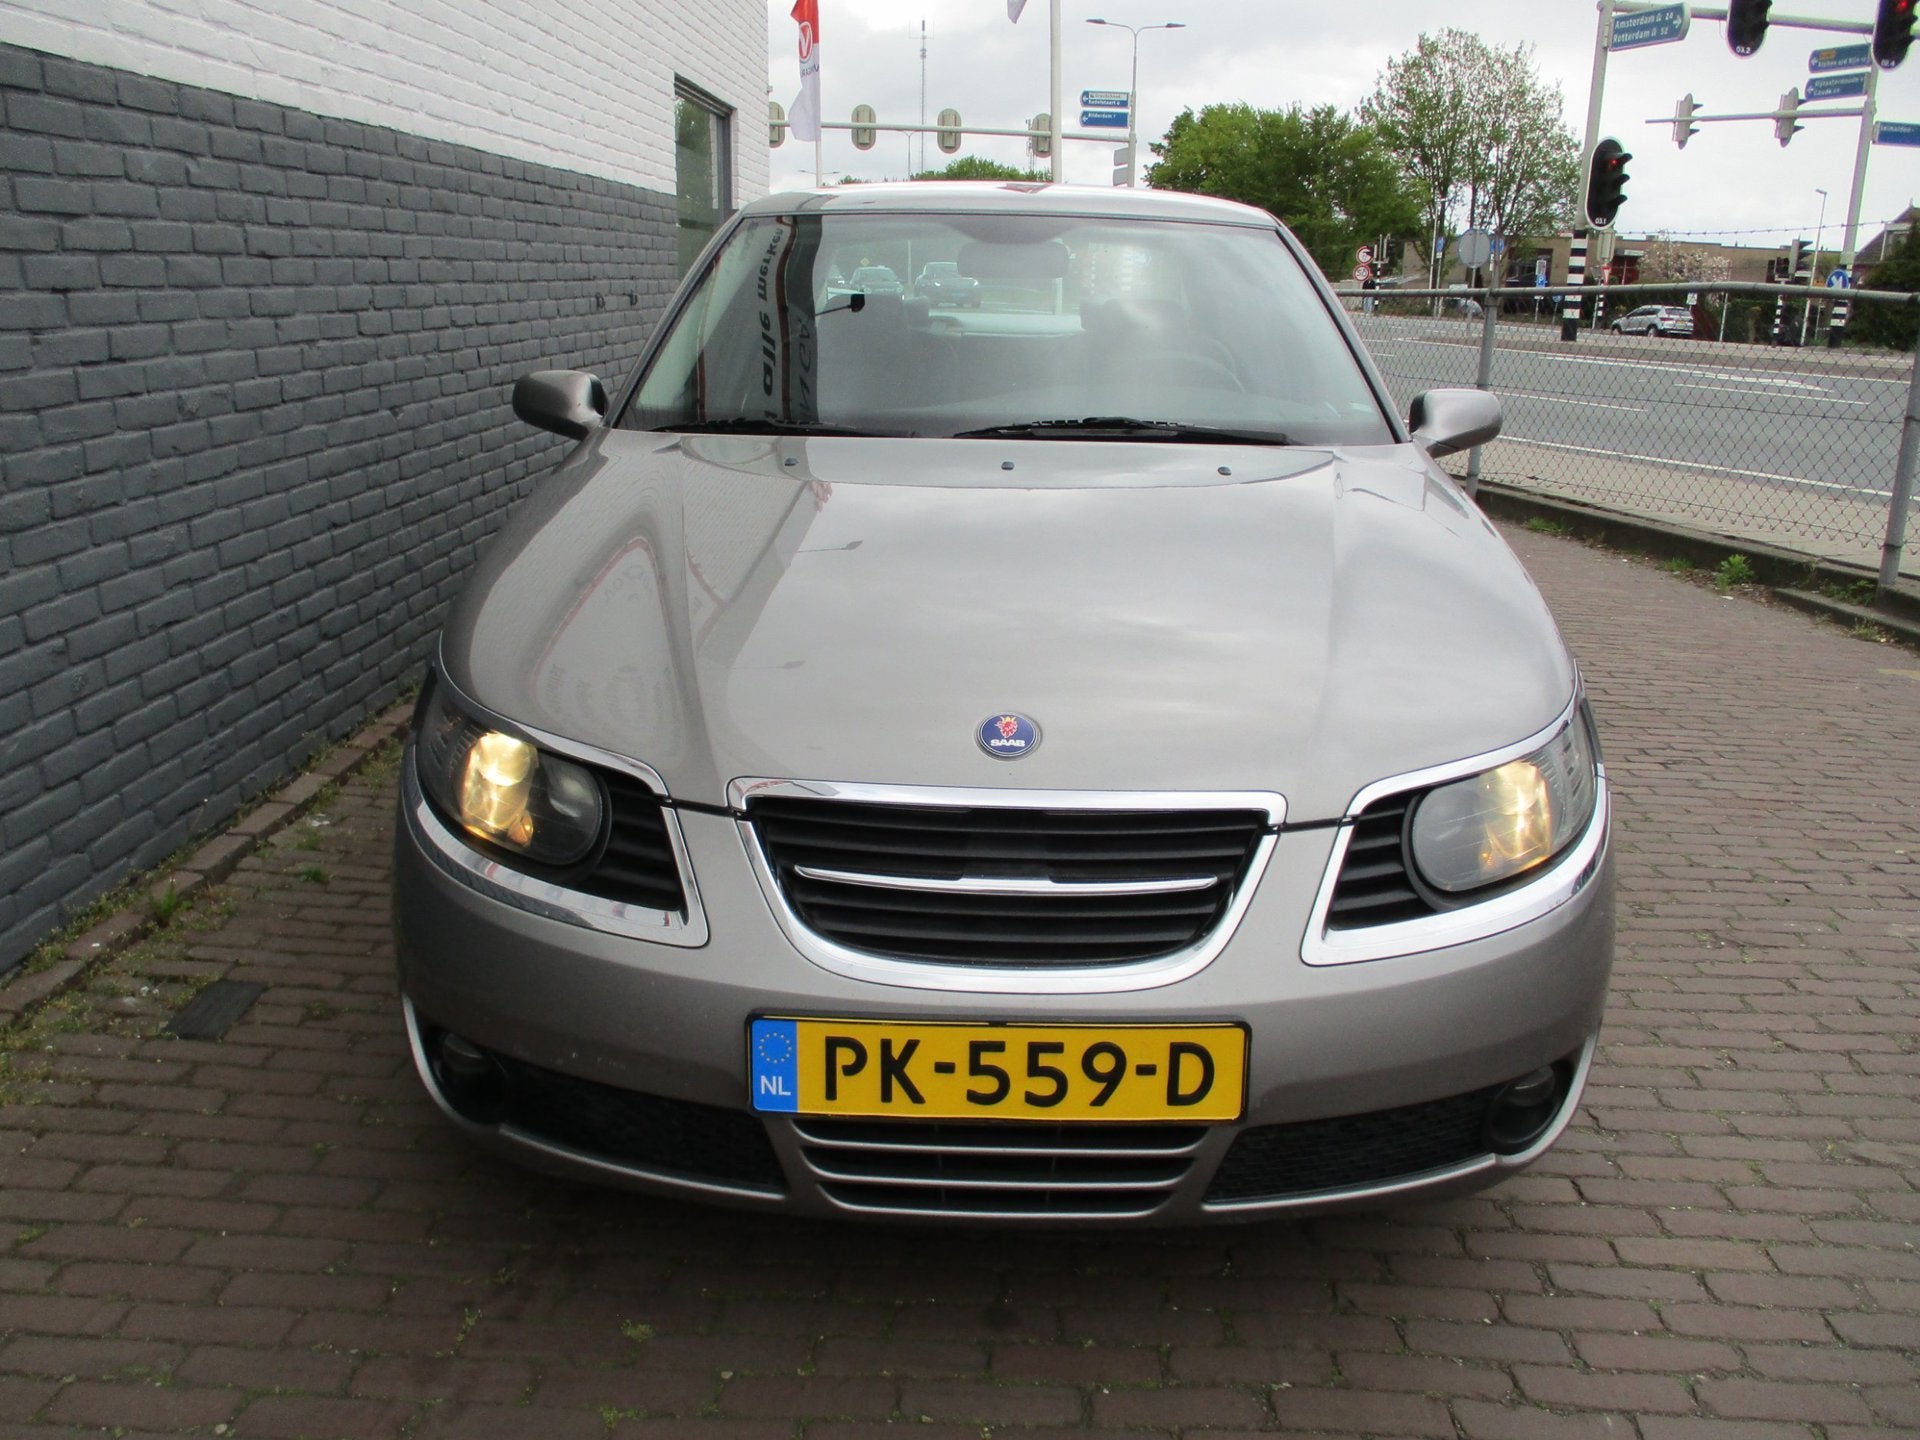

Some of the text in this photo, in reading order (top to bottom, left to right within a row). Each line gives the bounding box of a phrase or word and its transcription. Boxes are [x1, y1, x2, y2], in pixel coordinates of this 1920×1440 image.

[1615, 15, 1655, 29] Amsterdam
[1613, 30, 1651, 42] Rotterdam
[990, 739, 1026, 747] SAAB
[825, 1036, 1215, 1107] PK-559-D
[761, 1075, 792, 1098] NL
